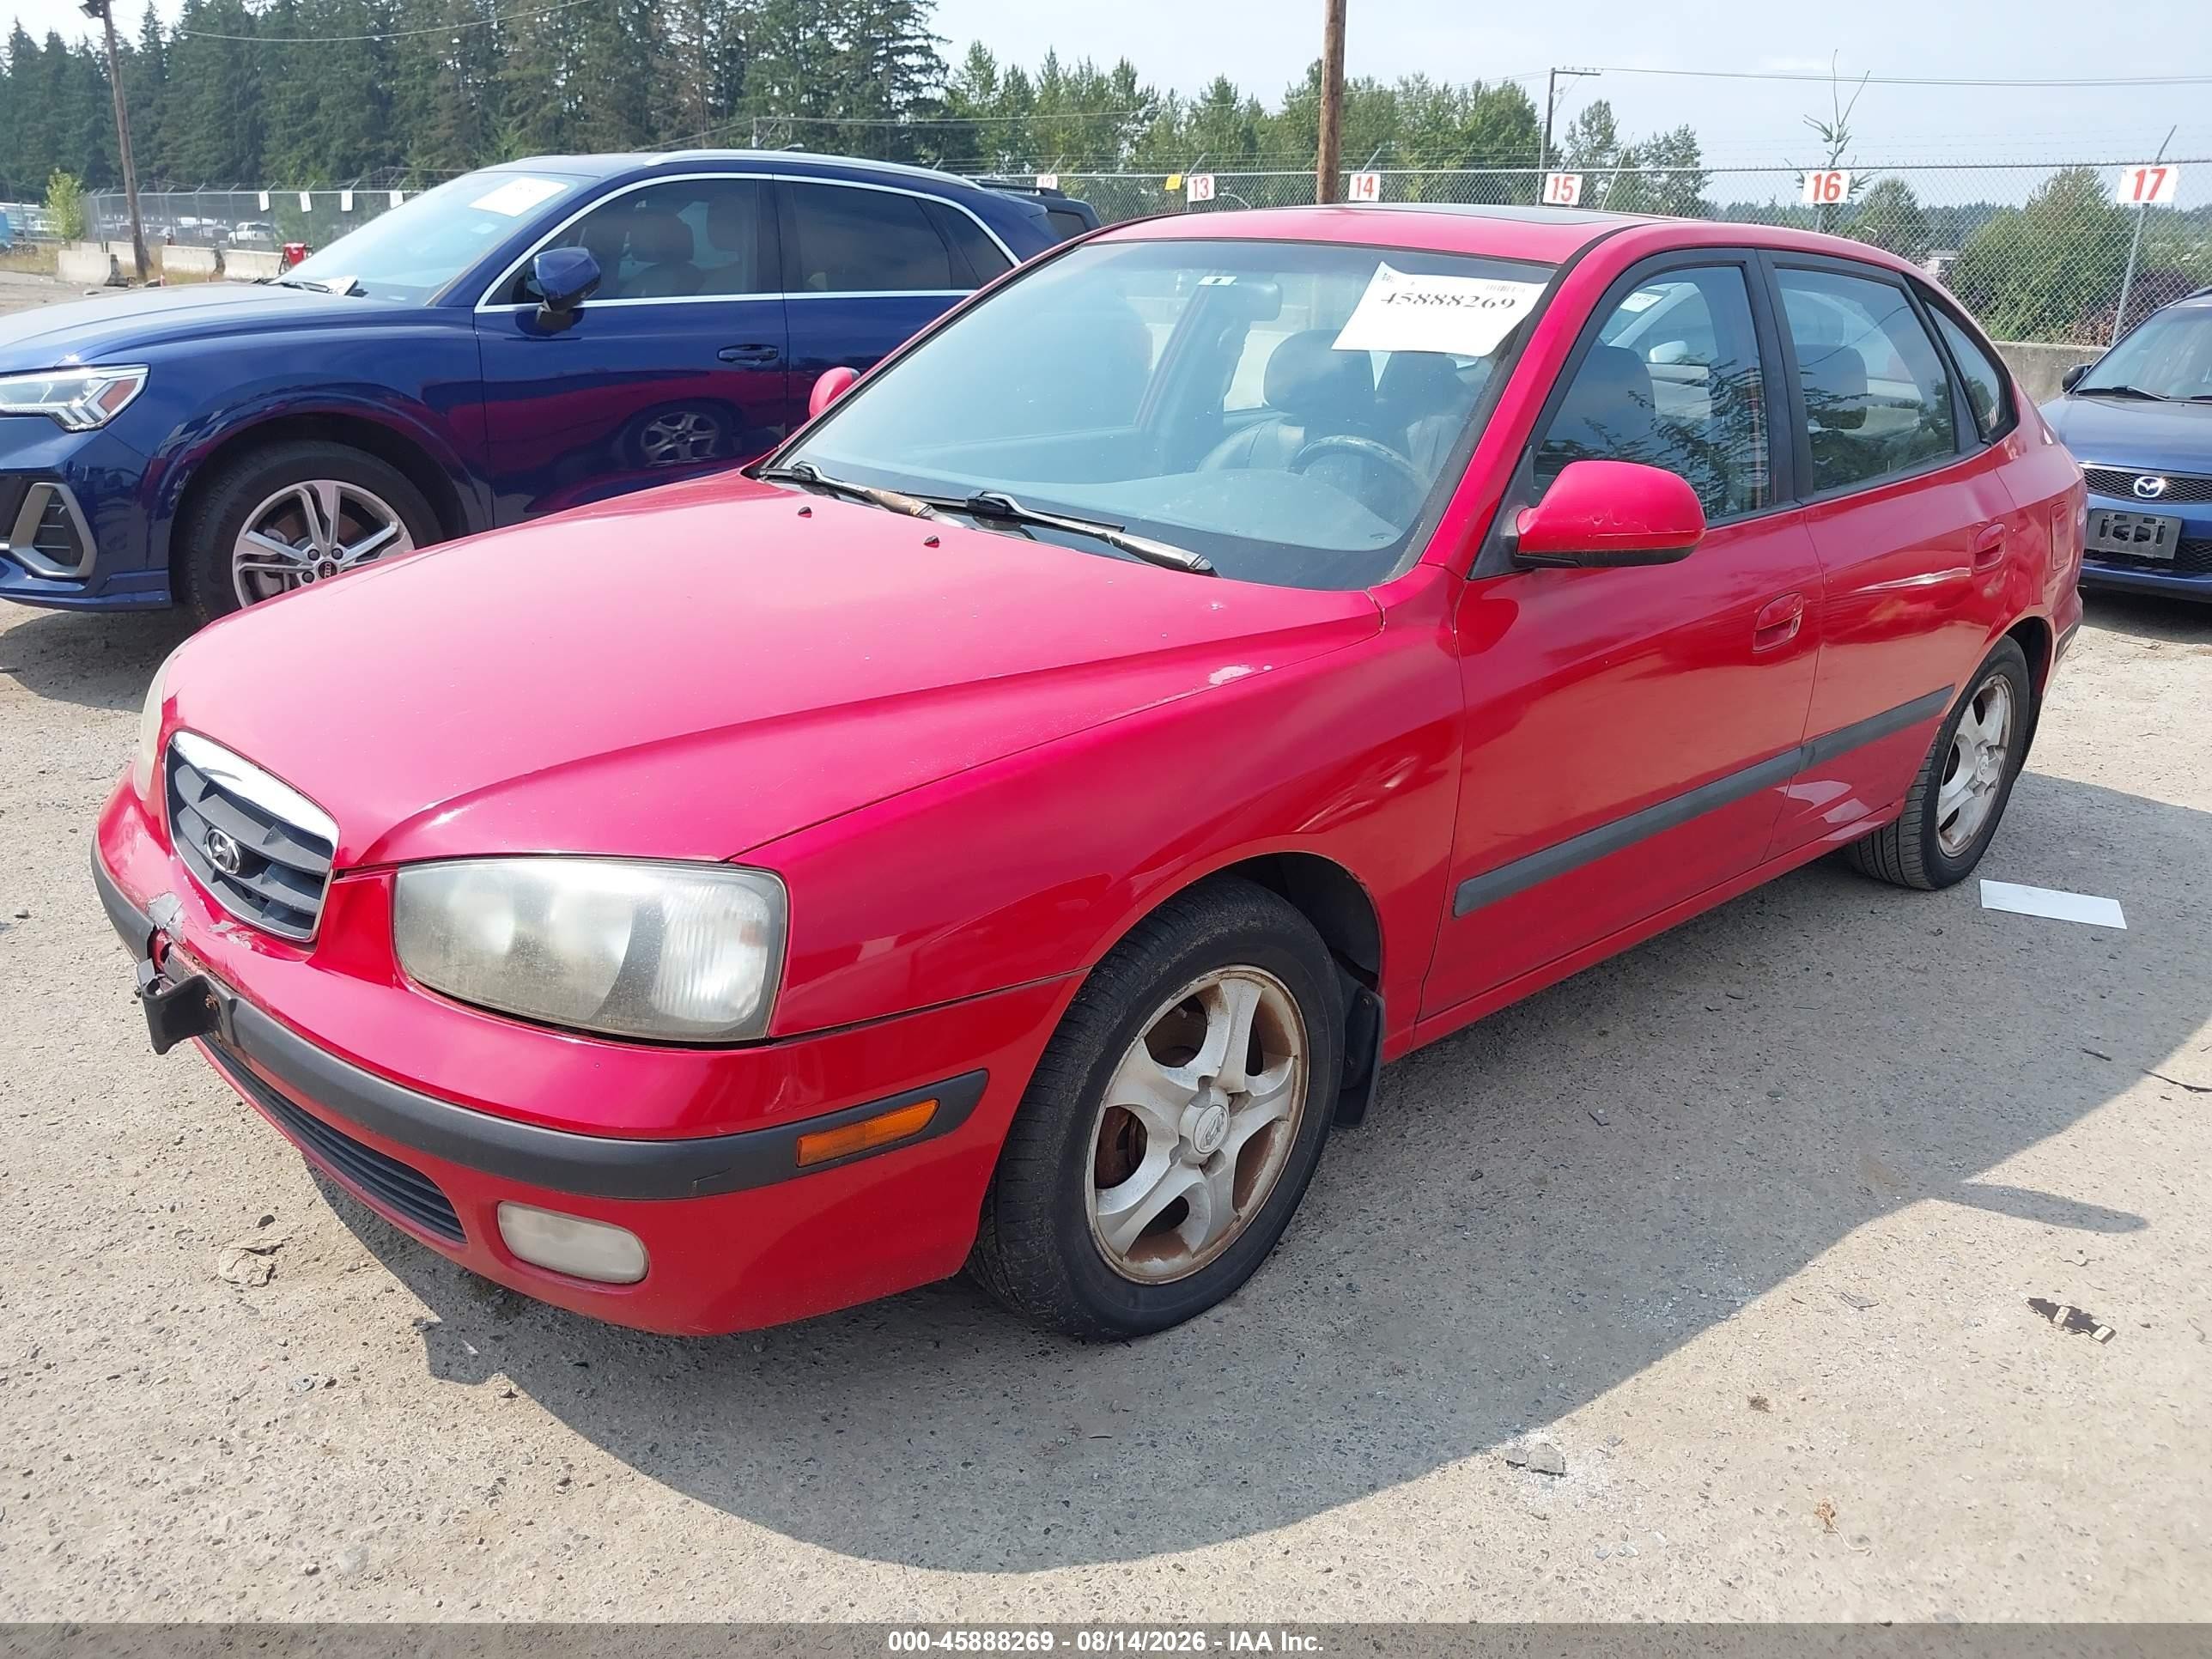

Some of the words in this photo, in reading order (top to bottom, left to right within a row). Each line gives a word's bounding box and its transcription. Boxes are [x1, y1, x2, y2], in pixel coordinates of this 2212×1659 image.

[1193, 177, 1209, 199] 13
[1356, 175, 1375, 198] 14
[1552, 175, 1574, 202] 15
[1813, 172, 1842, 202] 16
[2133, 167, 2167, 201] 17
[1380, 292, 1516, 309] 45888269
